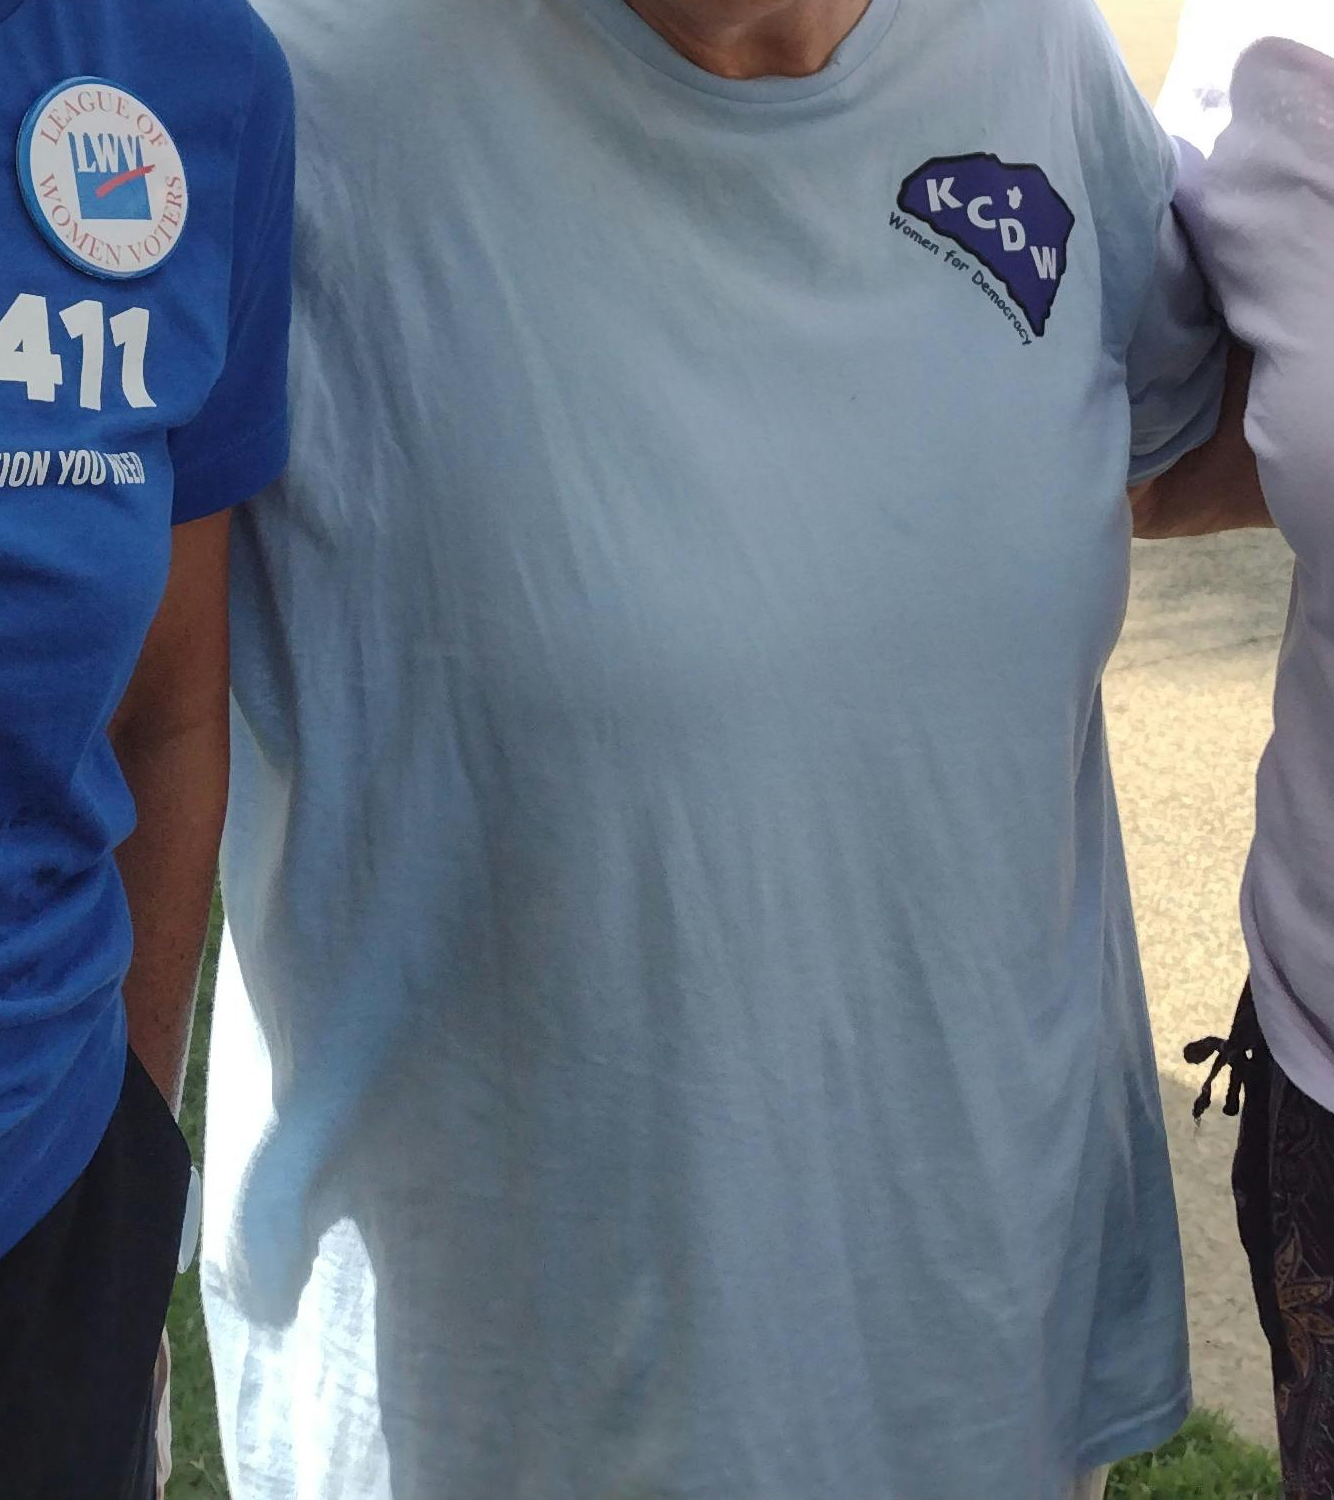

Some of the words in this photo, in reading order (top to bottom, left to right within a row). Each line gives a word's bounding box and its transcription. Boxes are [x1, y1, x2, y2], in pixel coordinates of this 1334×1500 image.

[40, 90, 130, 146] LEAGUE
[136, 112, 169, 148] OF
[73, 131, 144, 173] LWV
[38, 172, 121, 266] WOMEN
[128, 175, 184, 264] VOTERS
[925, 176, 1057, 280] KCDW
[888, 210, 940, 256] Women
[943, 249, 970, 273] for
[970, 269, 1033, 347] Democracy
[58, 449, 107, 486] YOU
[103, 451, 146, 485] NEED
